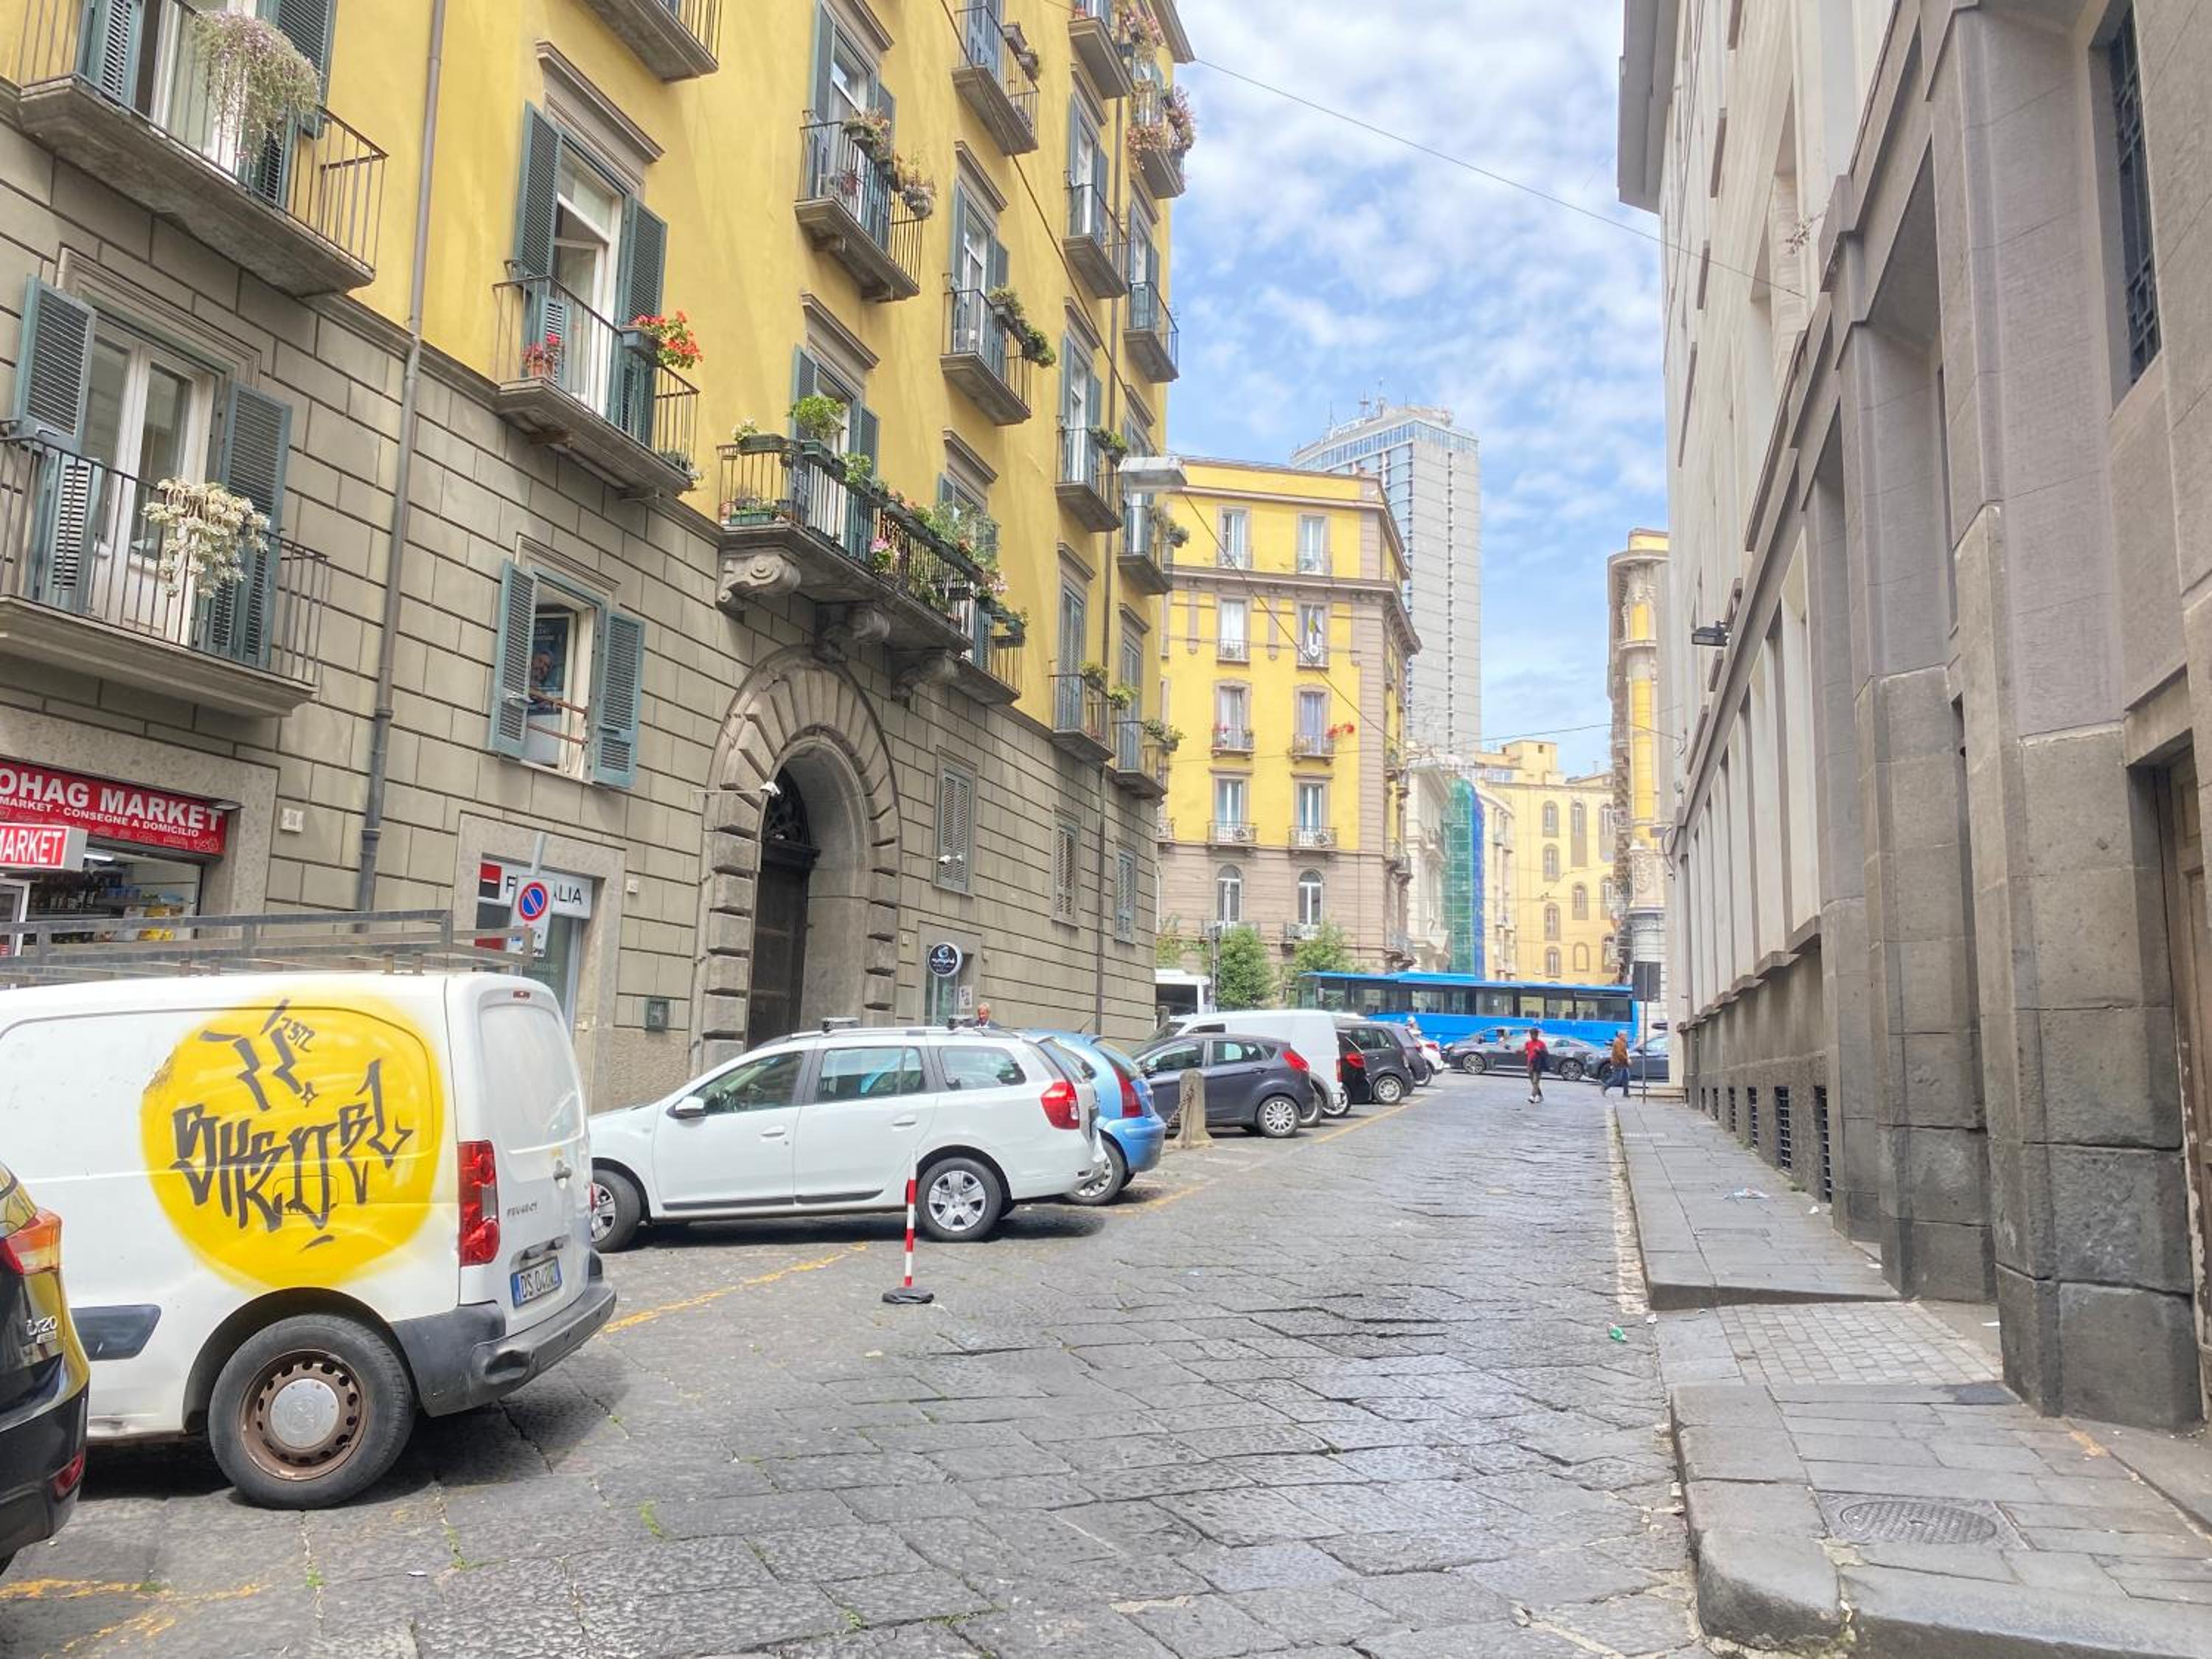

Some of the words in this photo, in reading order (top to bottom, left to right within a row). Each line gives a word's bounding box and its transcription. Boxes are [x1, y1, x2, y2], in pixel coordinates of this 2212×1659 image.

[63, 807, 128, 827] CONSEGNE
[131, 819, 139, 828] A
[142, 821, 199, 838] DOMICILIO
[100, 787, 223, 832] MARKET
